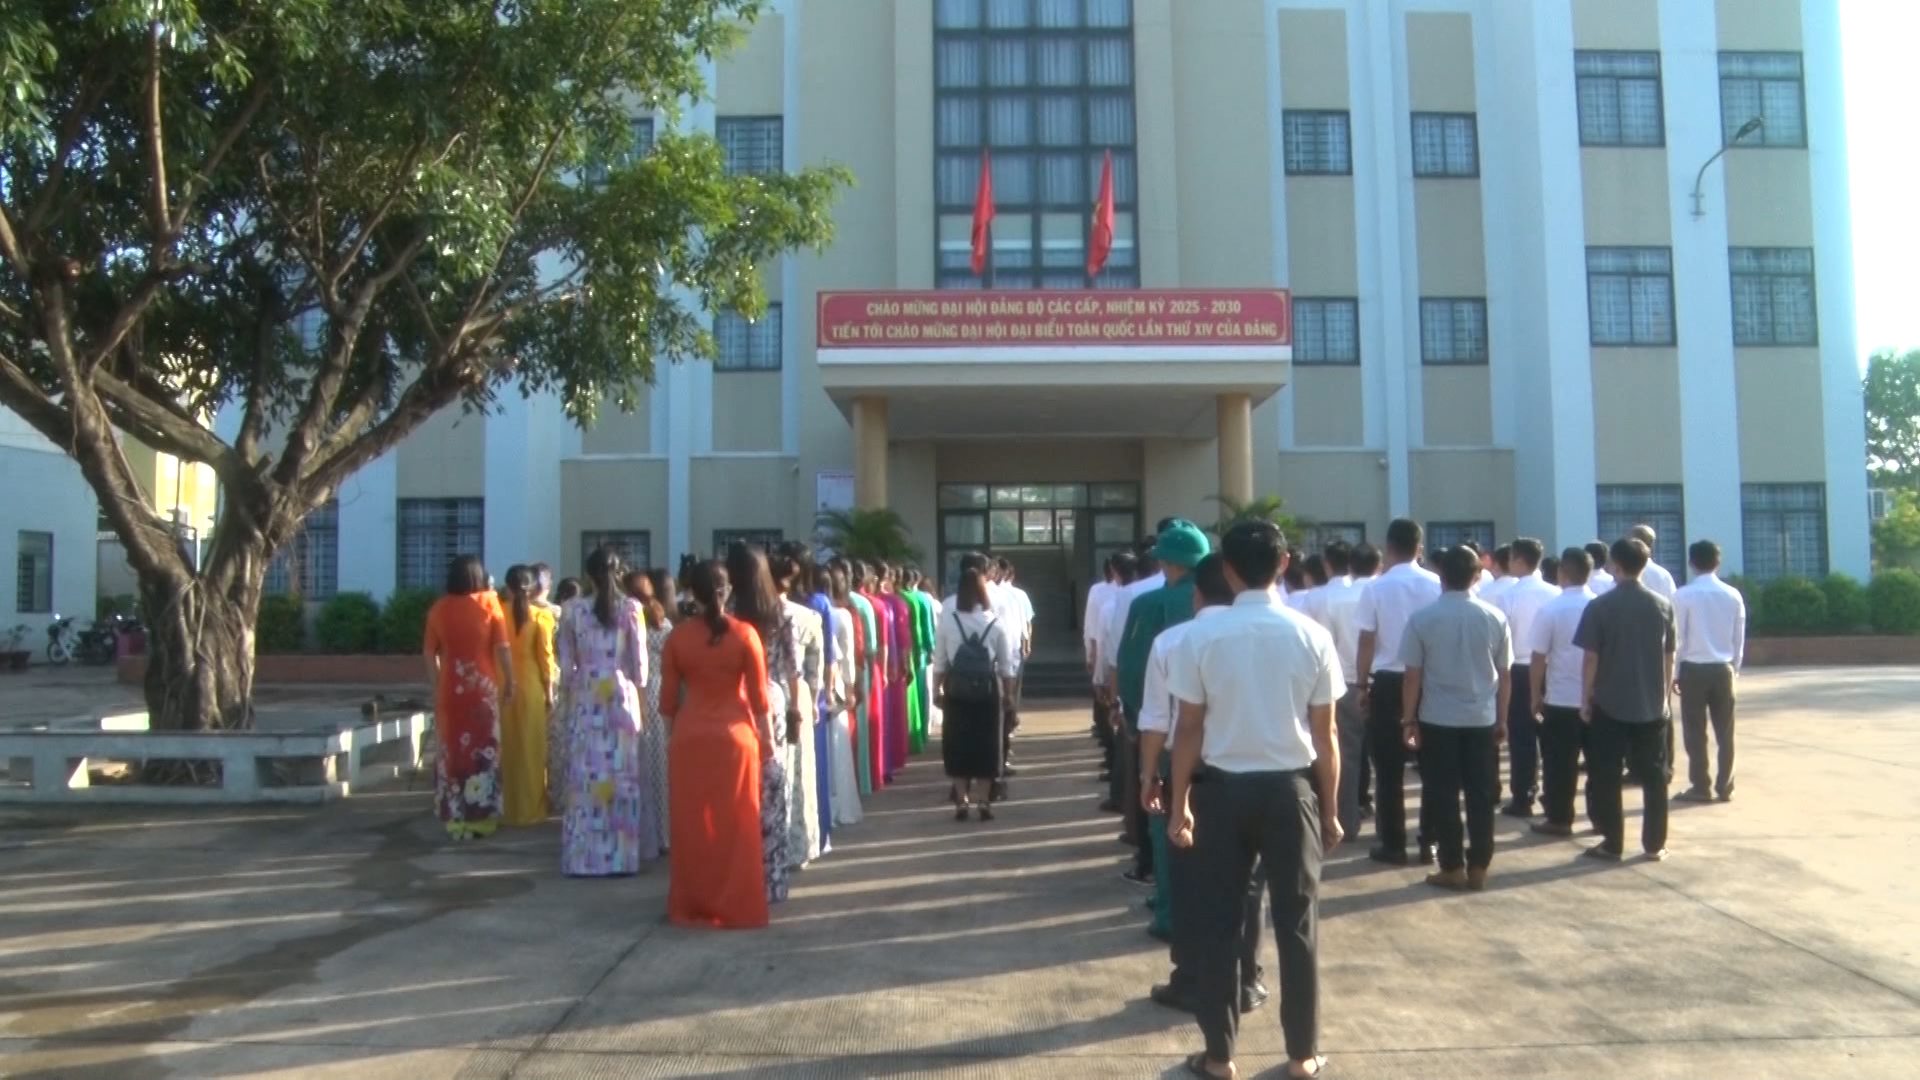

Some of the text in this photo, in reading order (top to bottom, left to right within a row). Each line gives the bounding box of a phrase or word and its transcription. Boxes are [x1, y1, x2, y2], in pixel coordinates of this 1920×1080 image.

[866, 298, 900, 316] CHÀO
[903, 298, 939, 316] MỪNG
[941, 301, 963, 318] ĐẠI
[966, 297, 988, 318] HỘI
[990, 296, 1024, 316] ĐẢNG
[1048, 297, 1072, 315] CÁC
[1074, 296, 1103, 316] CẤP,
[1106, 298, 1146, 316] NHIỆM
[1169, 299, 1200, 315] 2025
[1210, 299, 1242, 315] 2030
[832, 320, 860, 338] TIẾN
[886, 321, 920, 338] CHÀO
[922, 321, 959, 338] MỪNG
[961, 323, 983, 340] ĐẠI
[985, 321, 1008, 340] HỘI
[1010, 323, 1032, 340] ĐẠI
[1035, 318, 1065, 337] BIỂU
[1067, 319, 1100, 337] TOÀN
[1102, 318, 1135, 340] QUỐC
[1166, 319, 1192, 337] THỨ
[1194, 322, 1214, 337] XIV
[1216, 318, 1241, 337] CỦA
[1244, 318, 1278, 337] ĐẢNG
